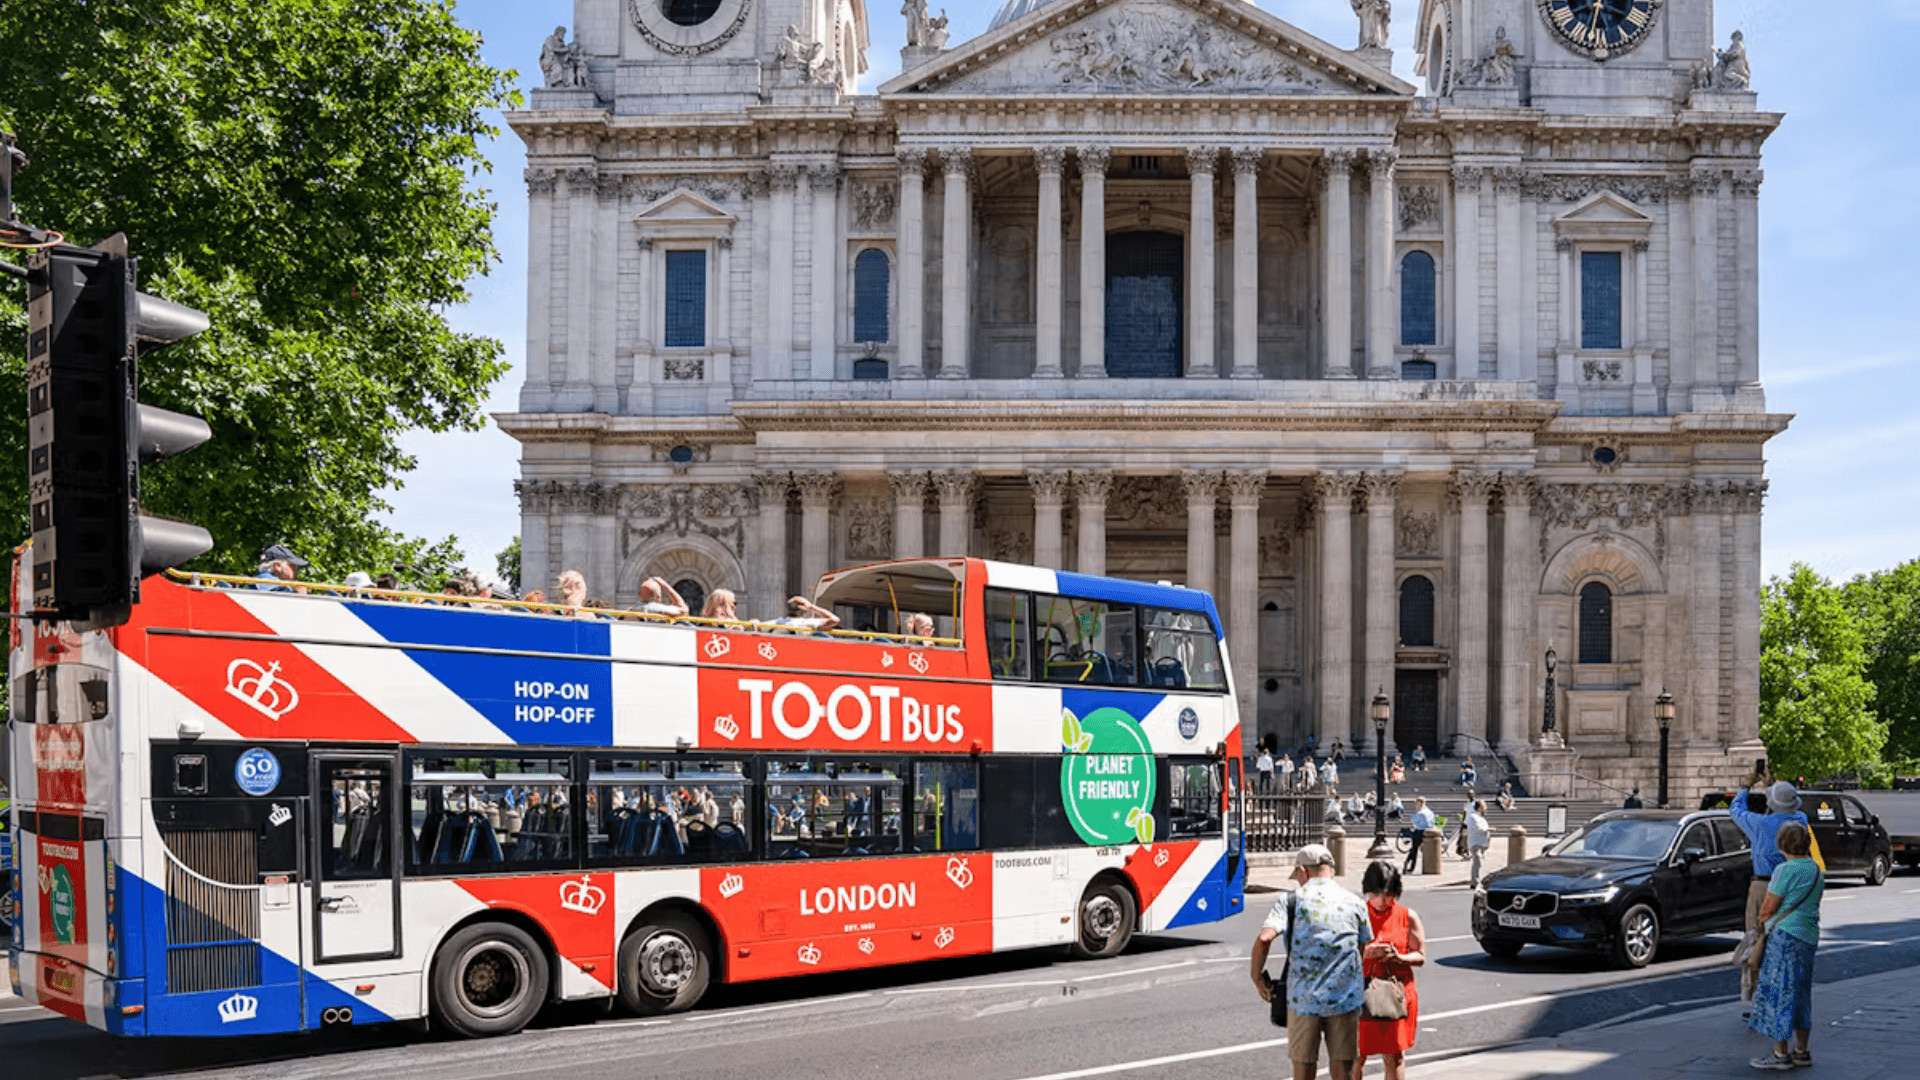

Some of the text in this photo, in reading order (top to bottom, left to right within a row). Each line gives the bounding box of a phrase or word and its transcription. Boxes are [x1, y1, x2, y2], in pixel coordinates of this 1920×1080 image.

[514, 680, 589, 700] HOP-ON
[514, 705, 596, 724] HOP-OFF
[242, 757, 272, 778] 60
[1086, 755, 1134, 775] PLANET
[1078, 780, 1140, 800] FRIENDLY
[995, 857, 1052, 868] TOOTBUS.COM
[800, 881, 916, 916] LONDON
